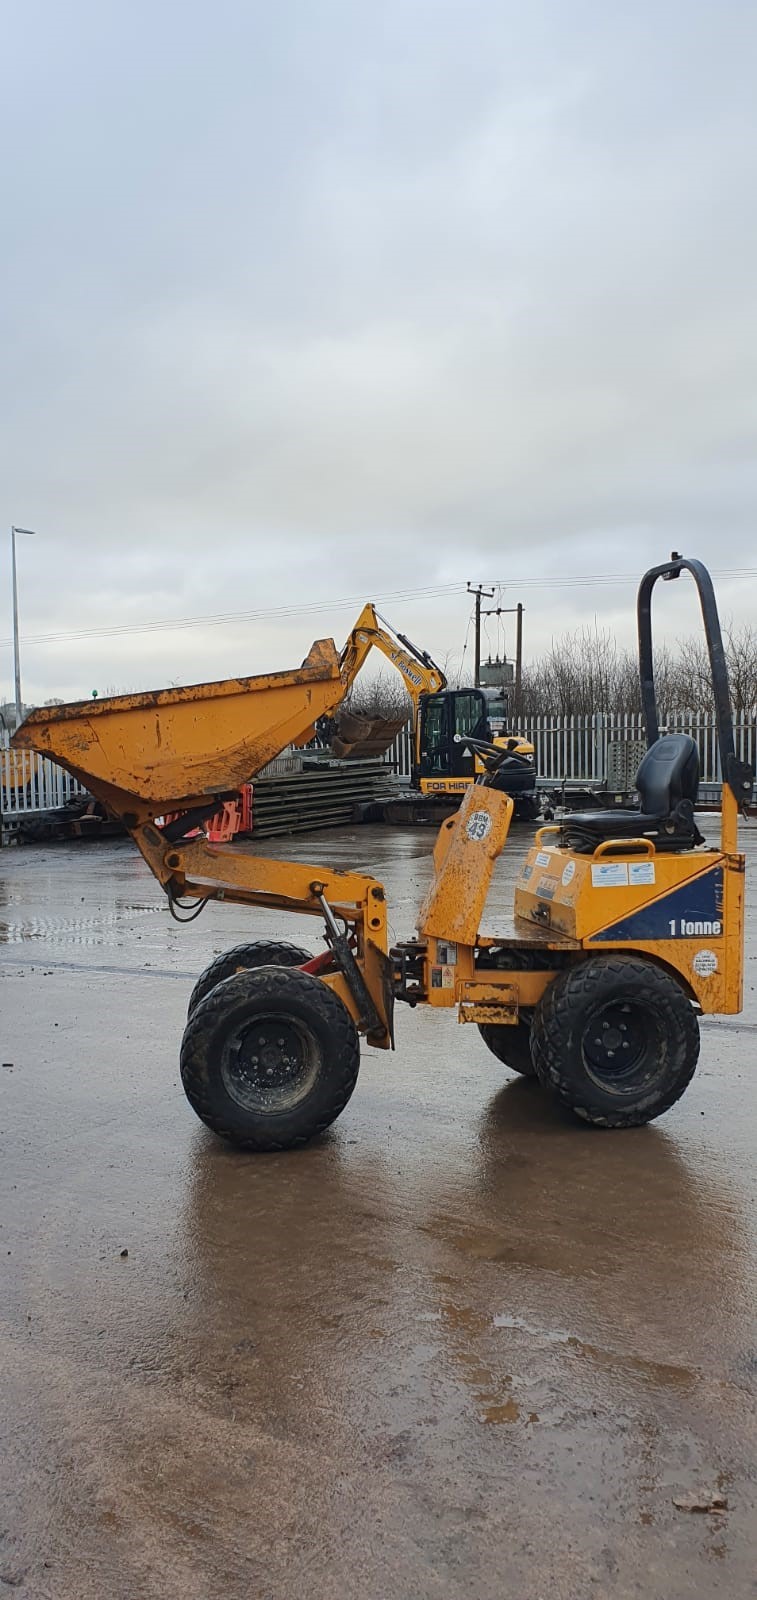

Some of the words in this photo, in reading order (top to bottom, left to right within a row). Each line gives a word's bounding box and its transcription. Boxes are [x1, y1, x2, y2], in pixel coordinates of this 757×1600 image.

[427, 782, 446, 790] FOR
[669, 919, 676, 936] 1
[680, 919, 721, 936] tonne
